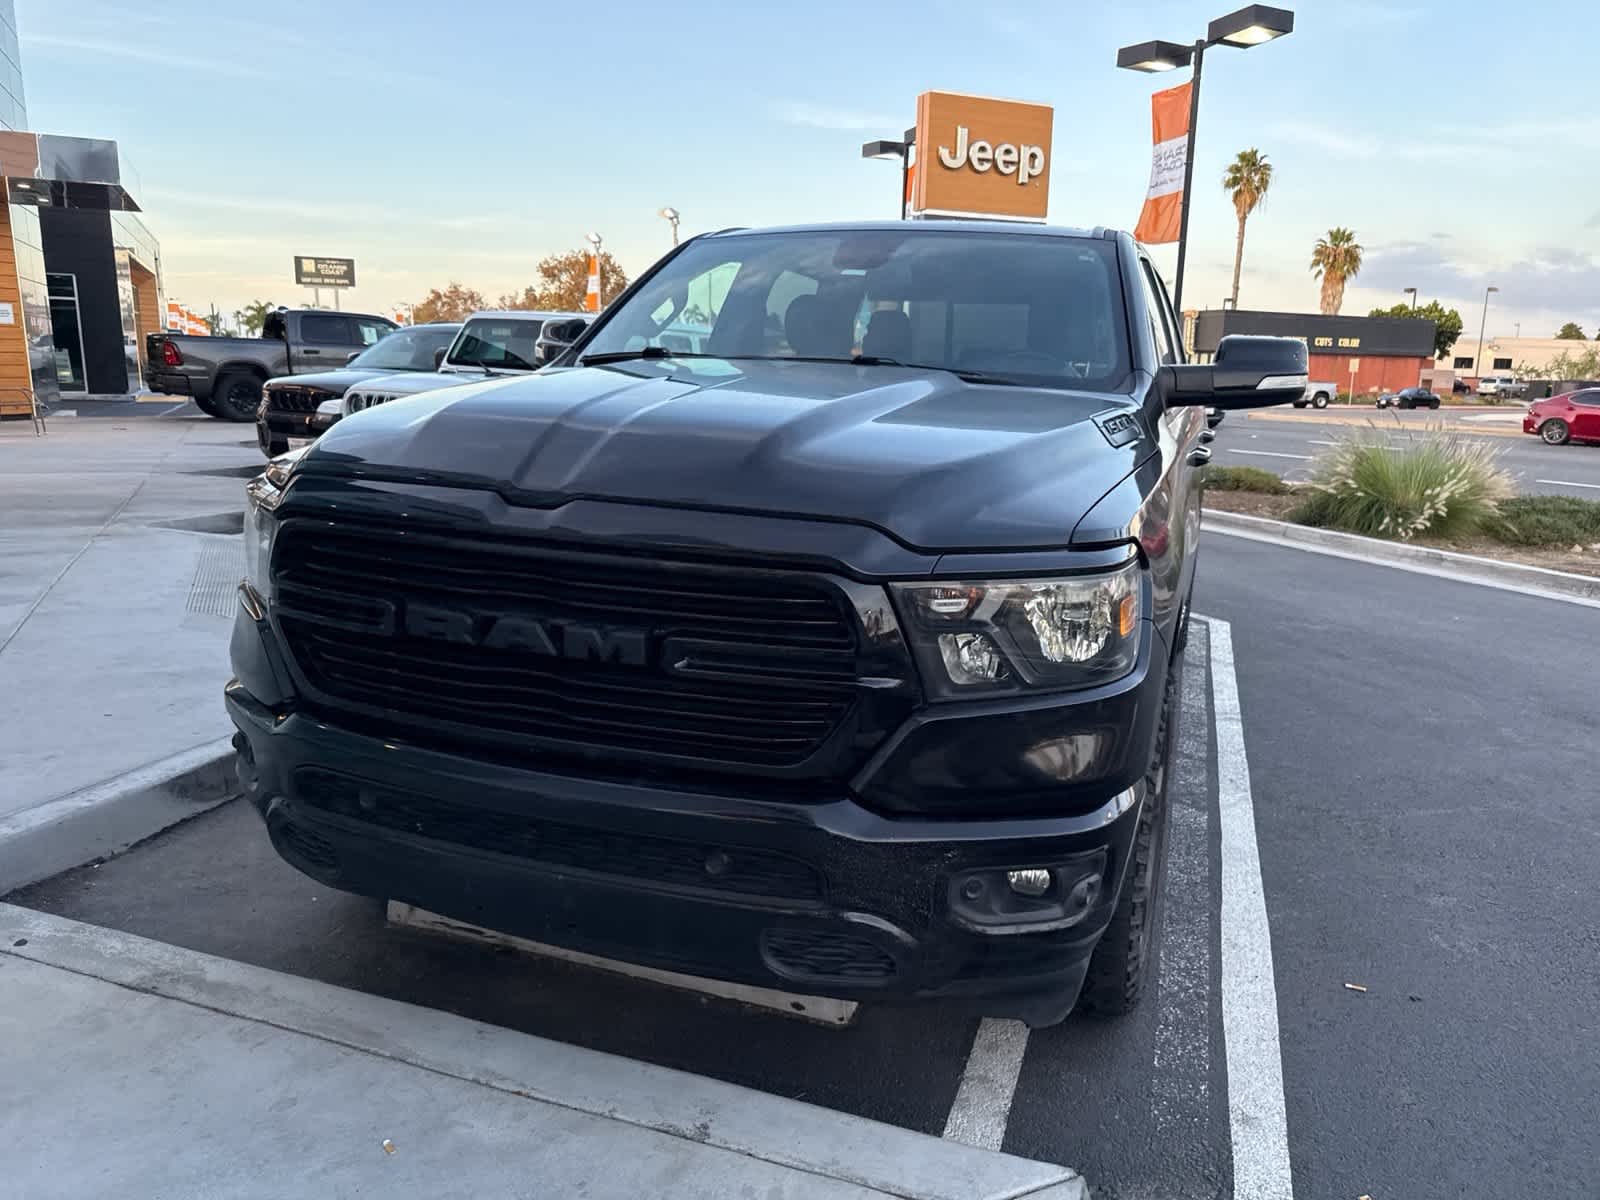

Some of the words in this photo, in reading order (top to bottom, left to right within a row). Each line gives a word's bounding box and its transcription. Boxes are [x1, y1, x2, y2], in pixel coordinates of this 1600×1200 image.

[938, 125, 1045, 184] Jeep
[1314, 336, 1333, 347] CUTS
[1105, 416, 1131, 434] 1500
[405, 602, 646, 665] RAM
